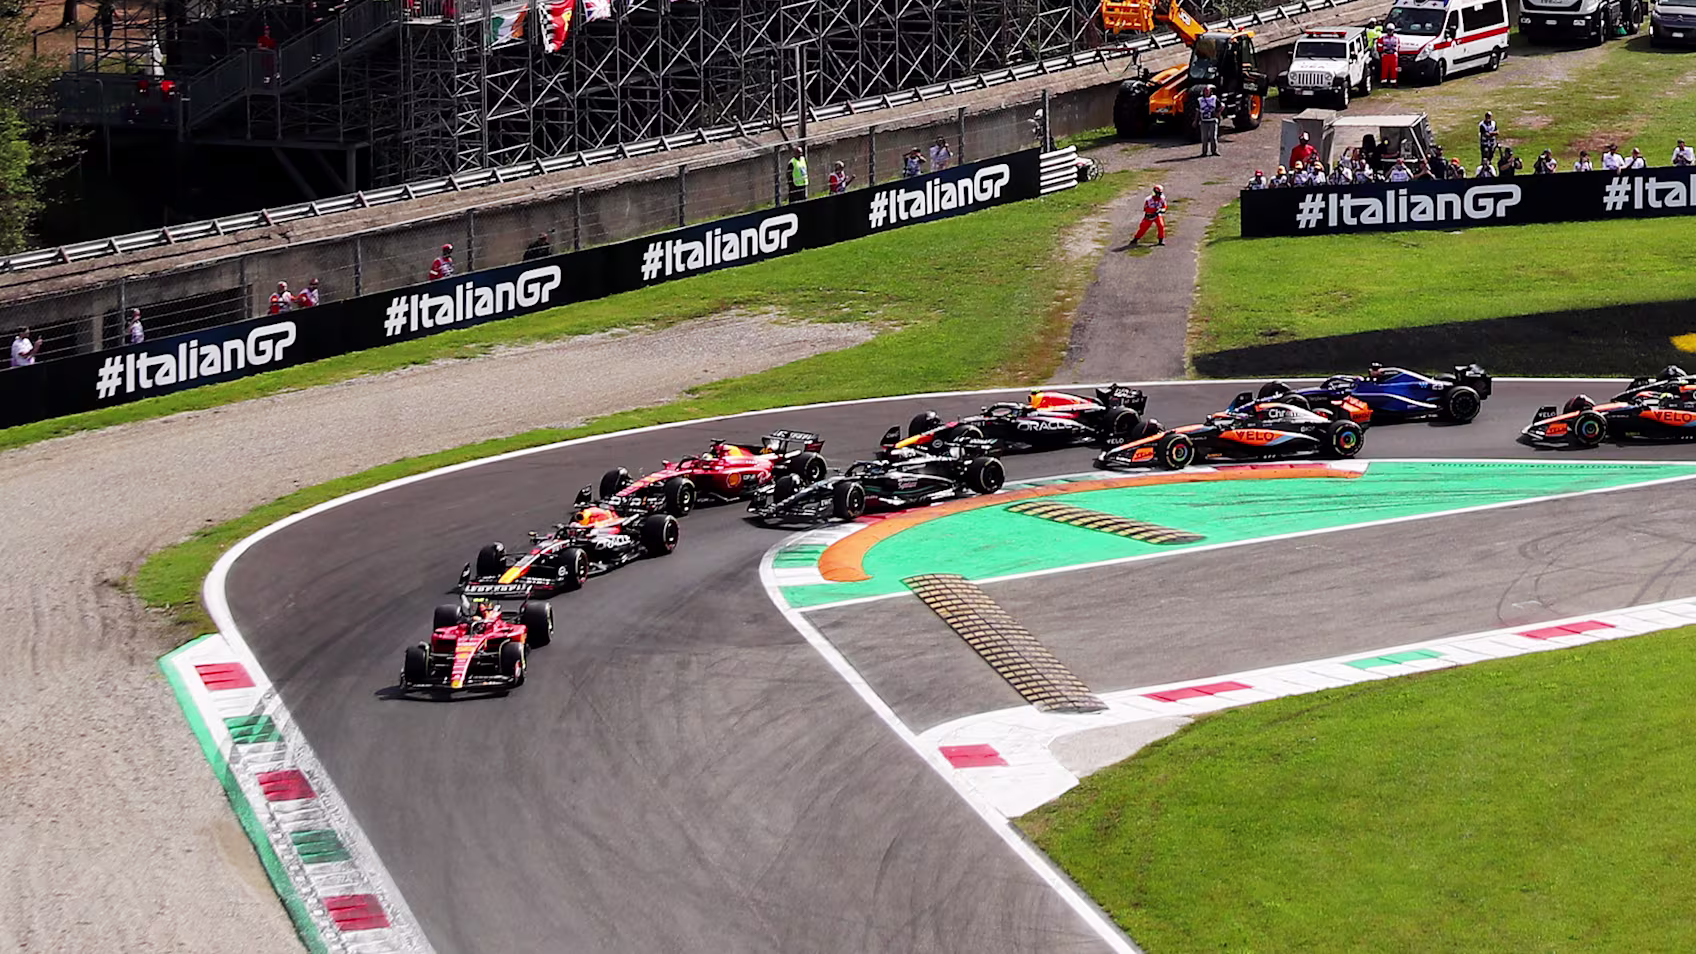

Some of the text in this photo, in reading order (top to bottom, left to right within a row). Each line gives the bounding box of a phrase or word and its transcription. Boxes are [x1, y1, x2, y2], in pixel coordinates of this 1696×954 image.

[869, 164, 1010, 228] #ItalianGP
[1296, 184, 1522, 228] #ItalianGP
[641, 213, 798, 280] #ItalianGP
[384, 265, 561, 336] #ItalianGP
[96, 322, 296, 399] #ItalianGP
[1235, 430, 1275, 442] VELO
[1653, 411, 1692, 423] VELO
